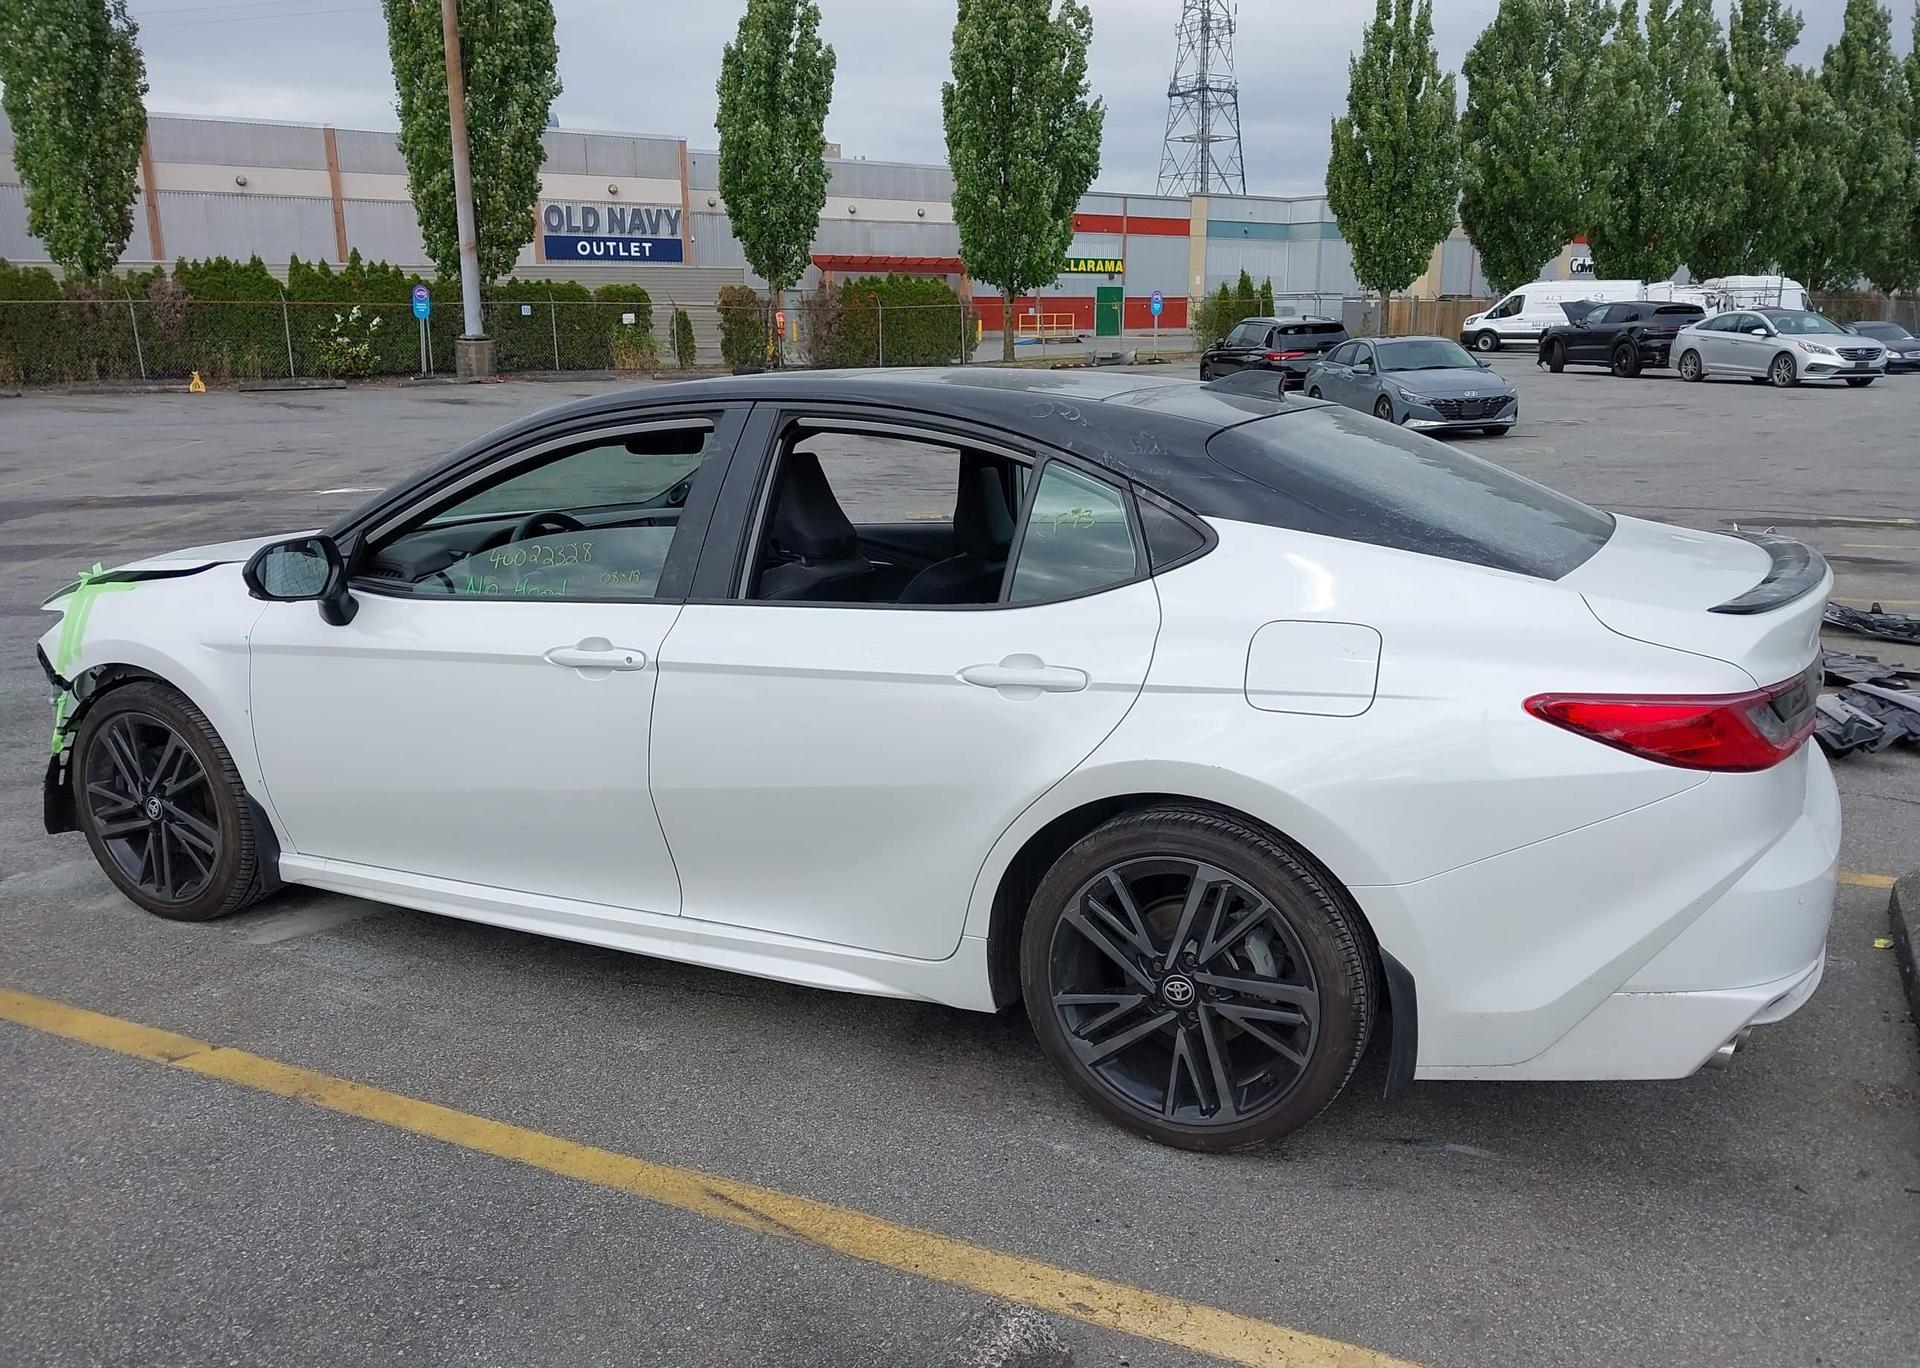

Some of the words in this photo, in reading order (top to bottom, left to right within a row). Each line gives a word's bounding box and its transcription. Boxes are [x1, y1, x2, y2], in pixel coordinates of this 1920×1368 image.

[543, 204, 599, 233] OLD
[607, 206, 681, 236] NAVY
[576, 240, 653, 257] OUTLET
